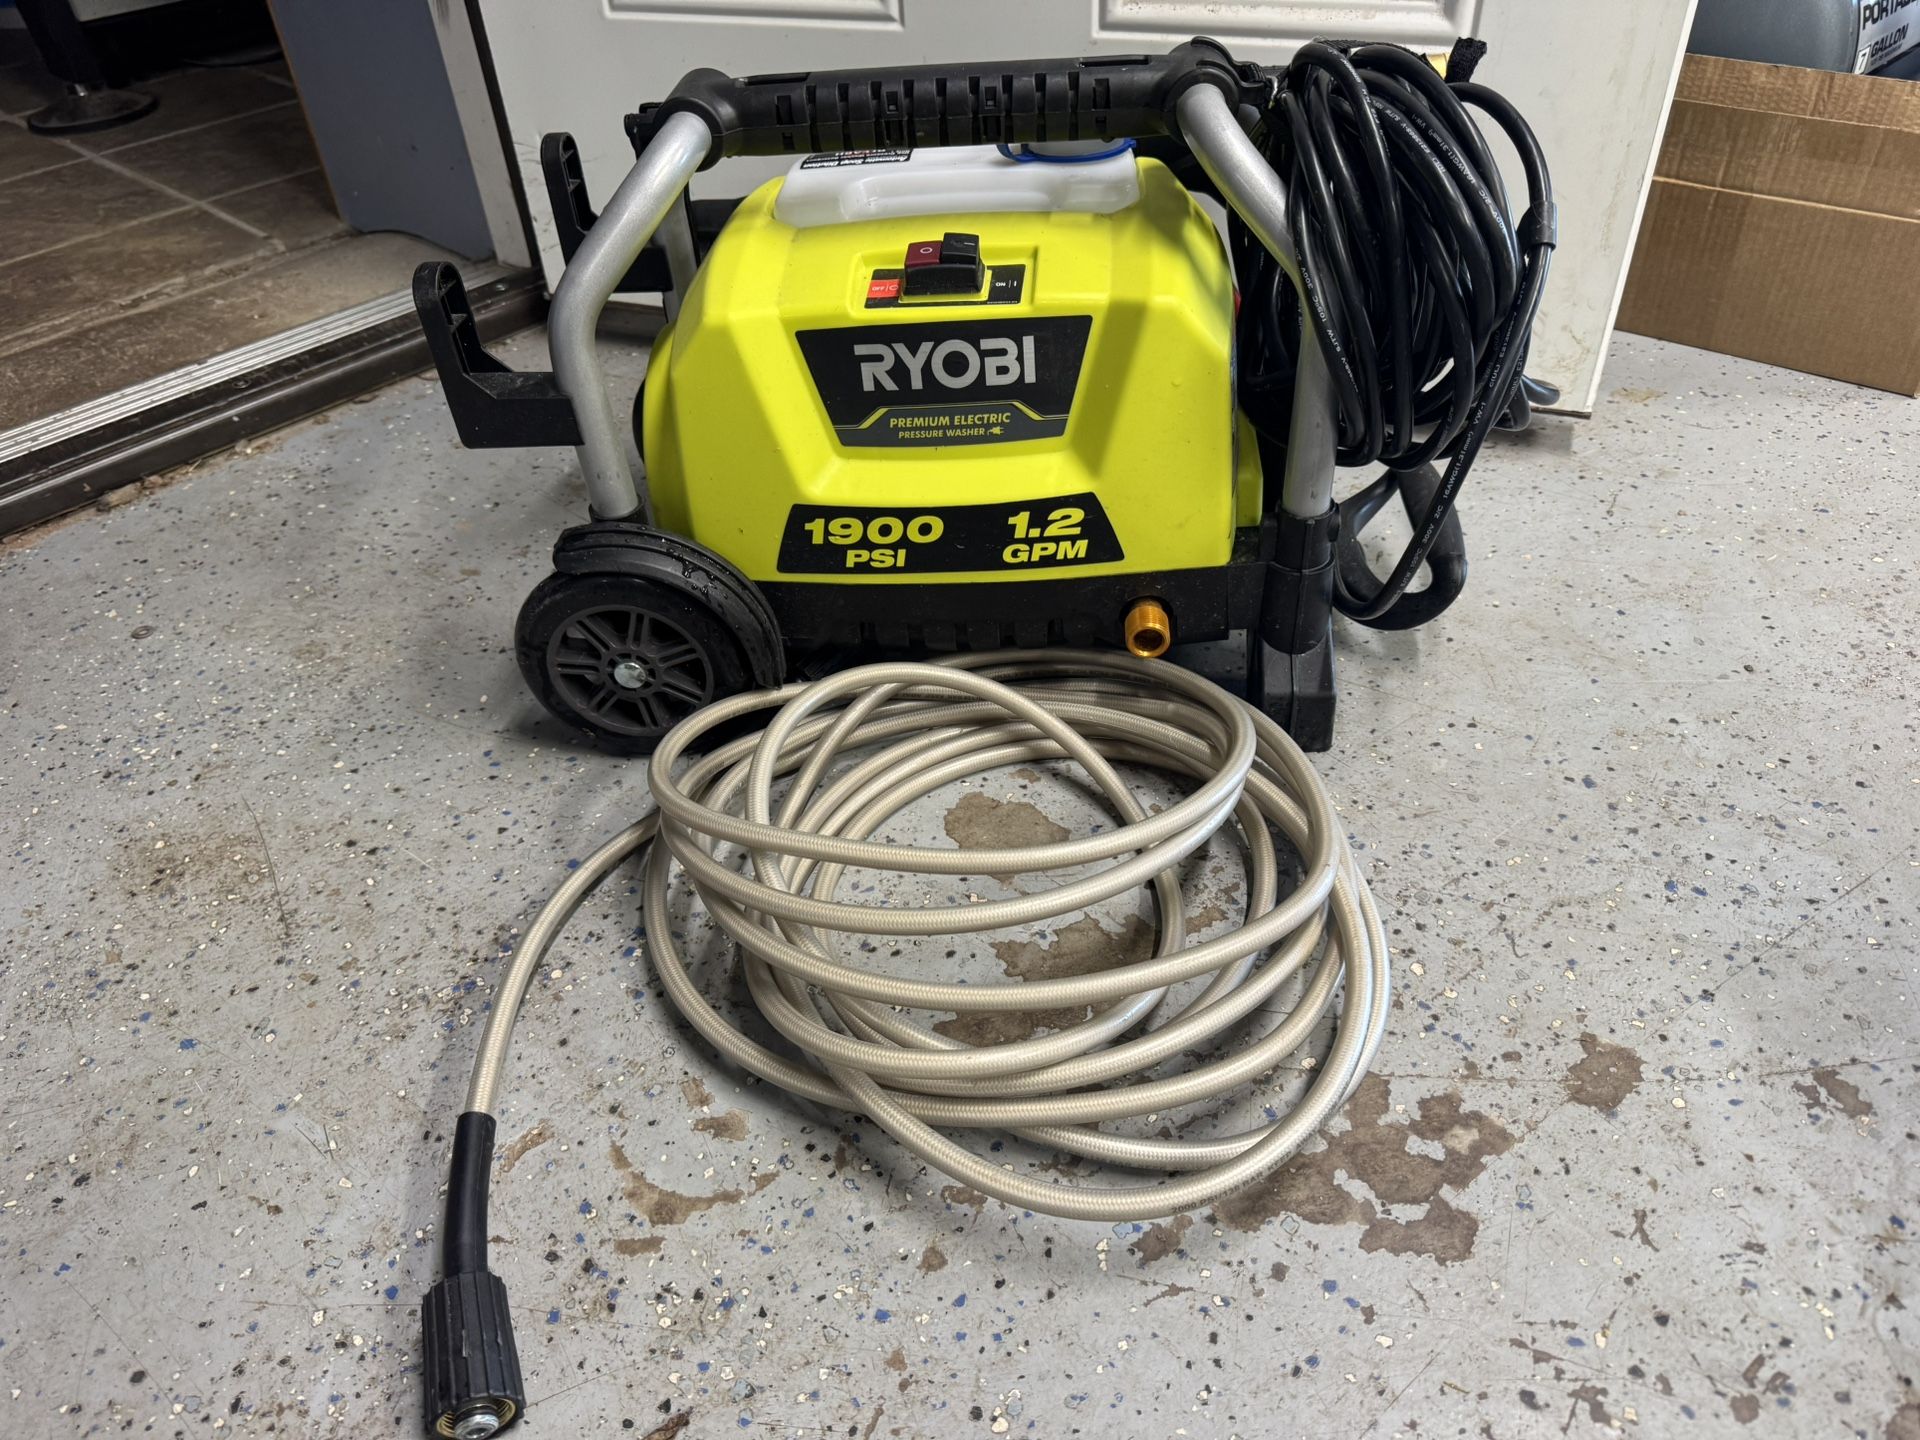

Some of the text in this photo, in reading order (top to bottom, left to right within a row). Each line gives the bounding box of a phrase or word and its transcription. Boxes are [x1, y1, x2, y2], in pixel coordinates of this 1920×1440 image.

[1859, 52, 1868, 72] 7
[1870, 23, 1909, 58] GALLON
[1301, 267, 1314, 290] 300V
[853, 335, 1037, 392] RYOBI
[889, 412, 1012, 428] PREMIUM ELECTRIC
[898, 427, 985, 439] PRESSURE WASHER
[1421, 523, 1435, 544] 300V
[1433, 504, 1444, 519] 2/C
[1473, 402, 1487, 425] VW-1
[804, 515, 945, 545] 1900
[1007, 507, 1086, 539] 1.2
[845, 549, 907, 569] PSI
[1001, 539, 1089, 564] GPM
[1171, 1202, 1197, 1214] 2000
